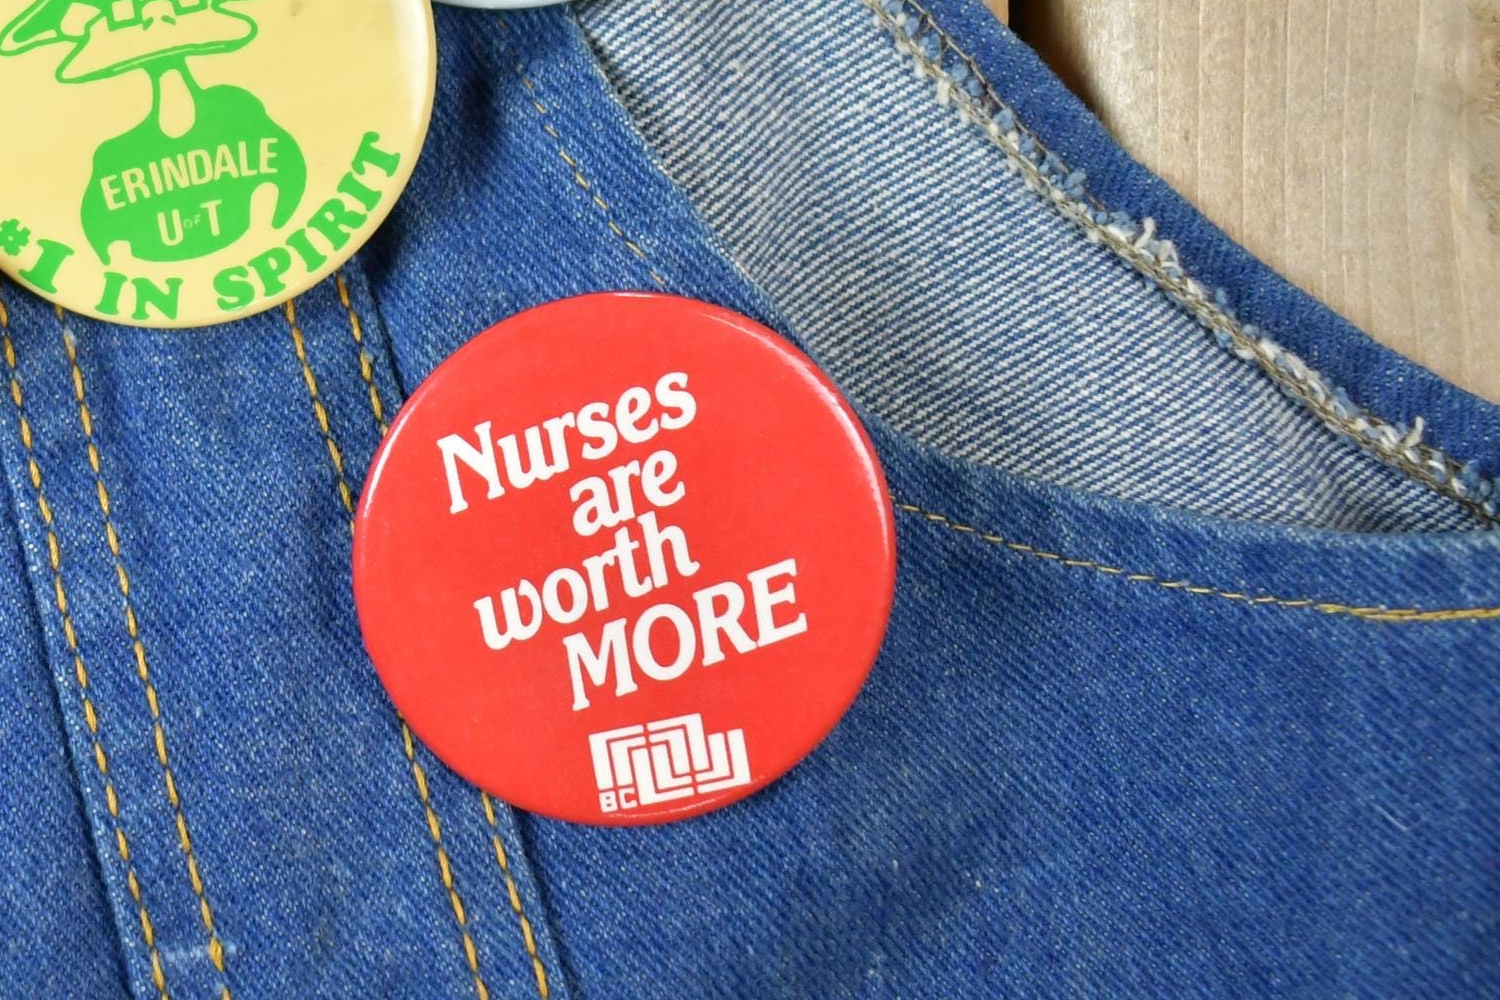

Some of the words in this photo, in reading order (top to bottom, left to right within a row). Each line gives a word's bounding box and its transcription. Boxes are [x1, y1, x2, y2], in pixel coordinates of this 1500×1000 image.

[95, 271, 183, 320] IN
[216, 131, 402, 313] SPIRIT
[100, 137, 279, 211] ERINDALE
[436, 371, 698, 514] Nurses
[569, 449, 686, 537] are
[473, 510, 700, 651] worth
[562, 558, 808, 712] MORE
